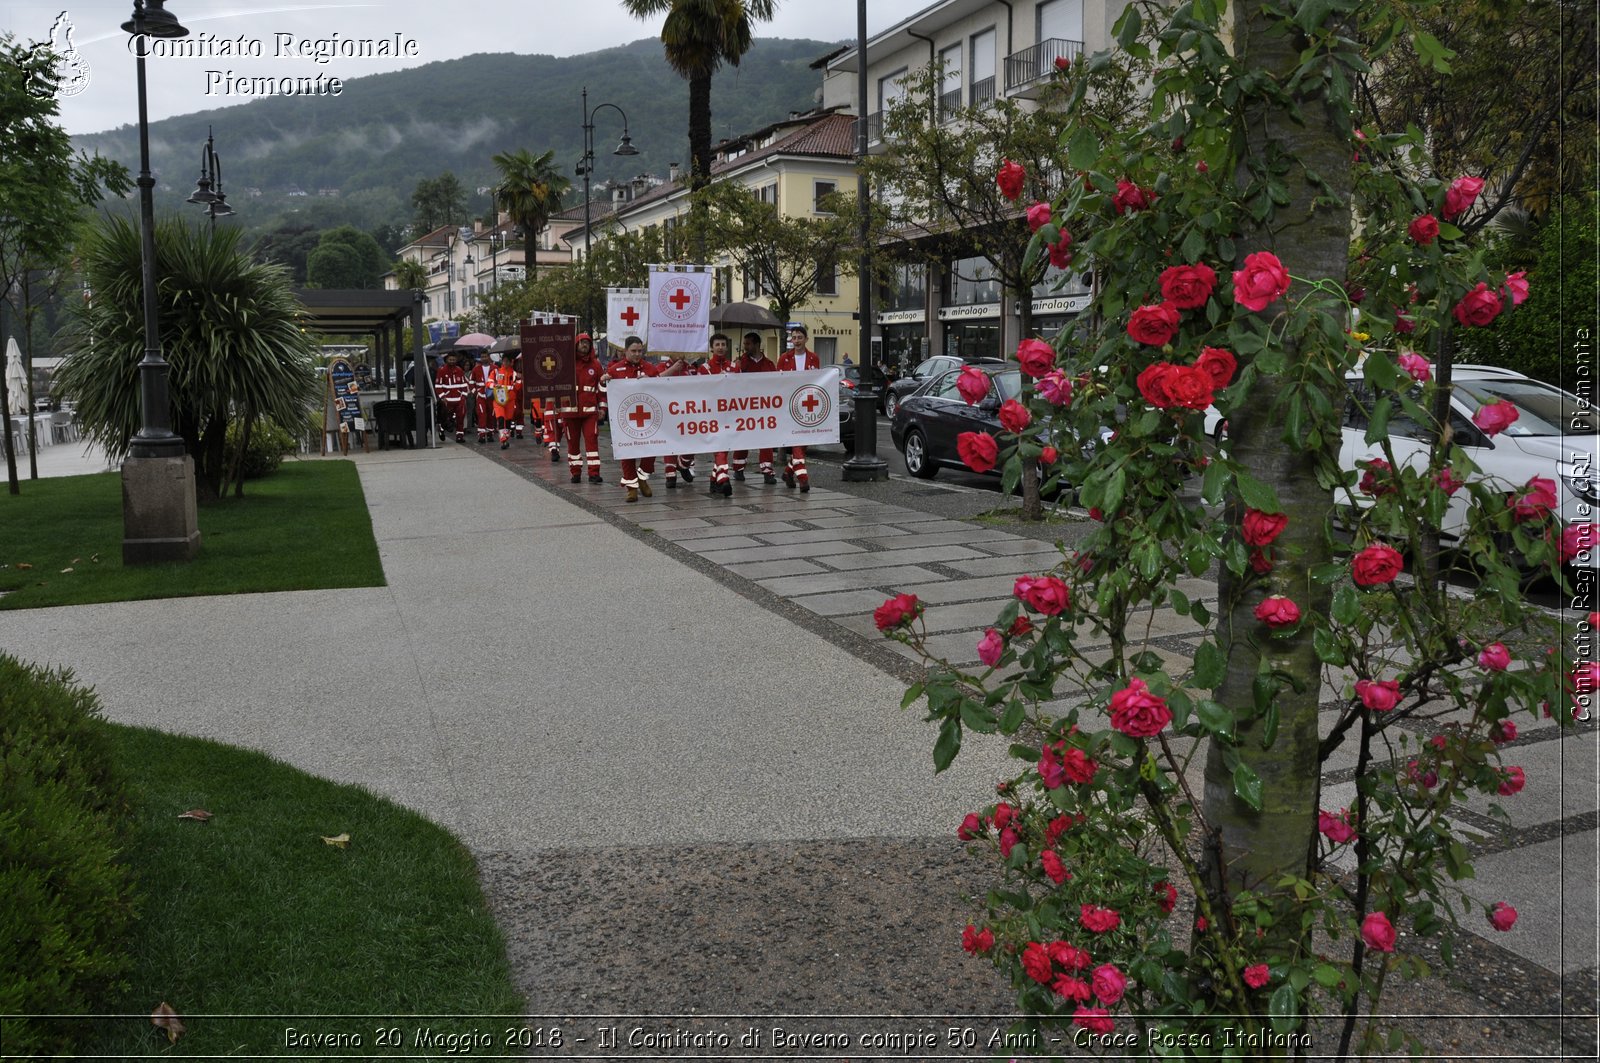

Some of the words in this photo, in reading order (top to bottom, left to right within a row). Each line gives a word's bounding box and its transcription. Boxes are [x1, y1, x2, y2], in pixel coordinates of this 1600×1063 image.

[951, 306, 988, 317] miralago
[1031, 299, 1076, 312] miralago
[888, 312, 917, 321] miralago
[668, 399, 712, 415] C.R.I.
[717, 396, 783, 412] BAVENO
[804, 413, 816, 422] 50
[676, 419, 719, 435] 1968
[735, 415, 777, 431] 2018
